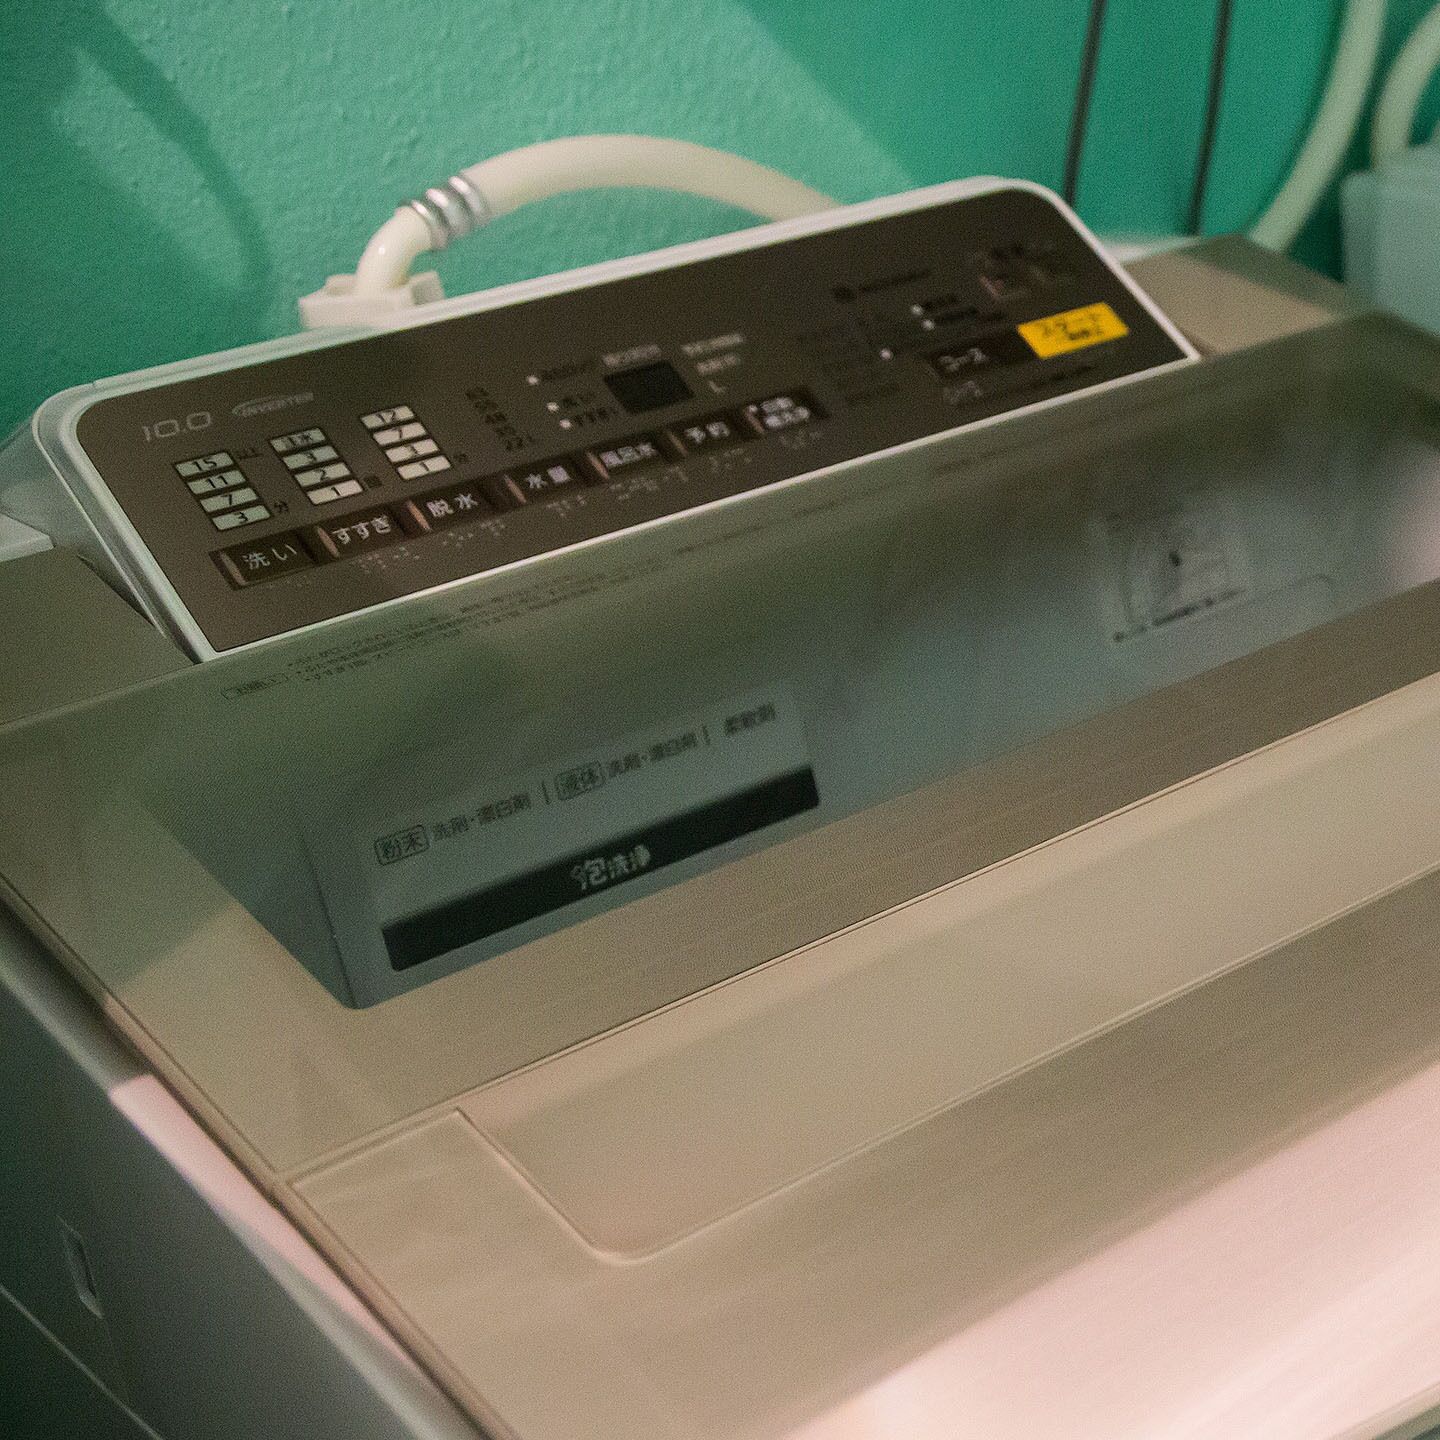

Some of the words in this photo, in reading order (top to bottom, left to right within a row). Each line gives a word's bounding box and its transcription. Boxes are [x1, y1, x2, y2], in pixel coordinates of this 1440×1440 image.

[376, 411, 398, 424] 12
[142, 411, 212, 441] 10.0
[192, 457, 218, 473] 15
[304, 452, 317, 464] 3
[206, 475, 229, 488] 11
[316, 467, 330, 481] 2
[524, 464, 571, 490] 水量
[332, 486, 343, 498] 1
[222, 494, 235, 507] 7
[427, 492, 479, 519] 脱水
[237, 511, 249, 524] 3
[333, 514, 393, 546] すすぎ
[242, 543, 299, 572] 洗い
[380, 831, 424, 860] 粉末
